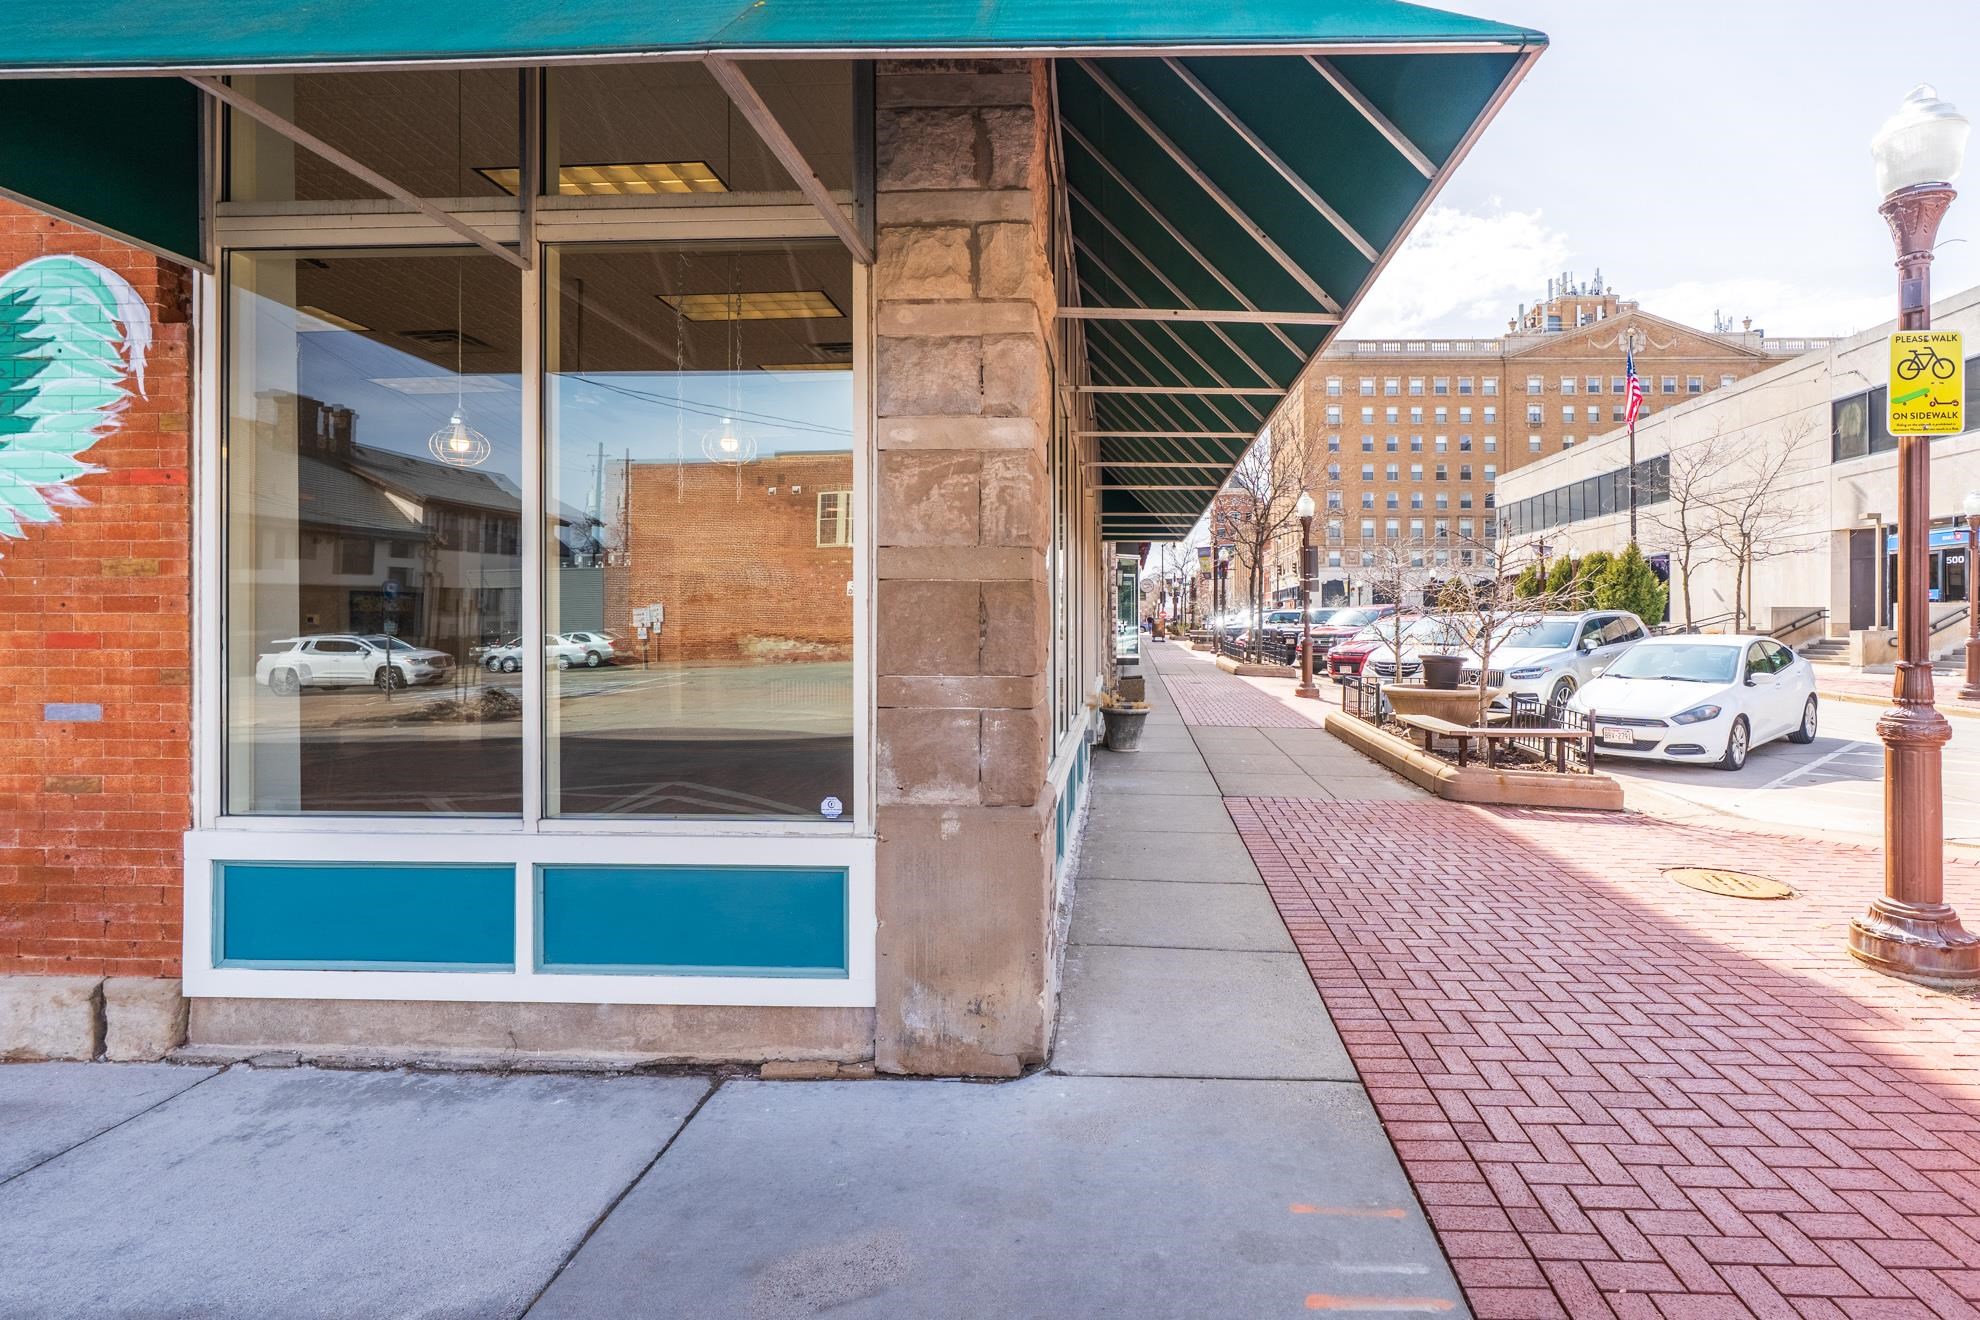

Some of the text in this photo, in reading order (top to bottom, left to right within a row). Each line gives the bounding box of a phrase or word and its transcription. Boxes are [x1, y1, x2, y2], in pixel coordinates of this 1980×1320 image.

[1895, 334, 1958, 343] PLEASE WALK
[1892, 411, 1958, 420] ON SIDEWALK
[1946, 555, 1965, 564] 500
